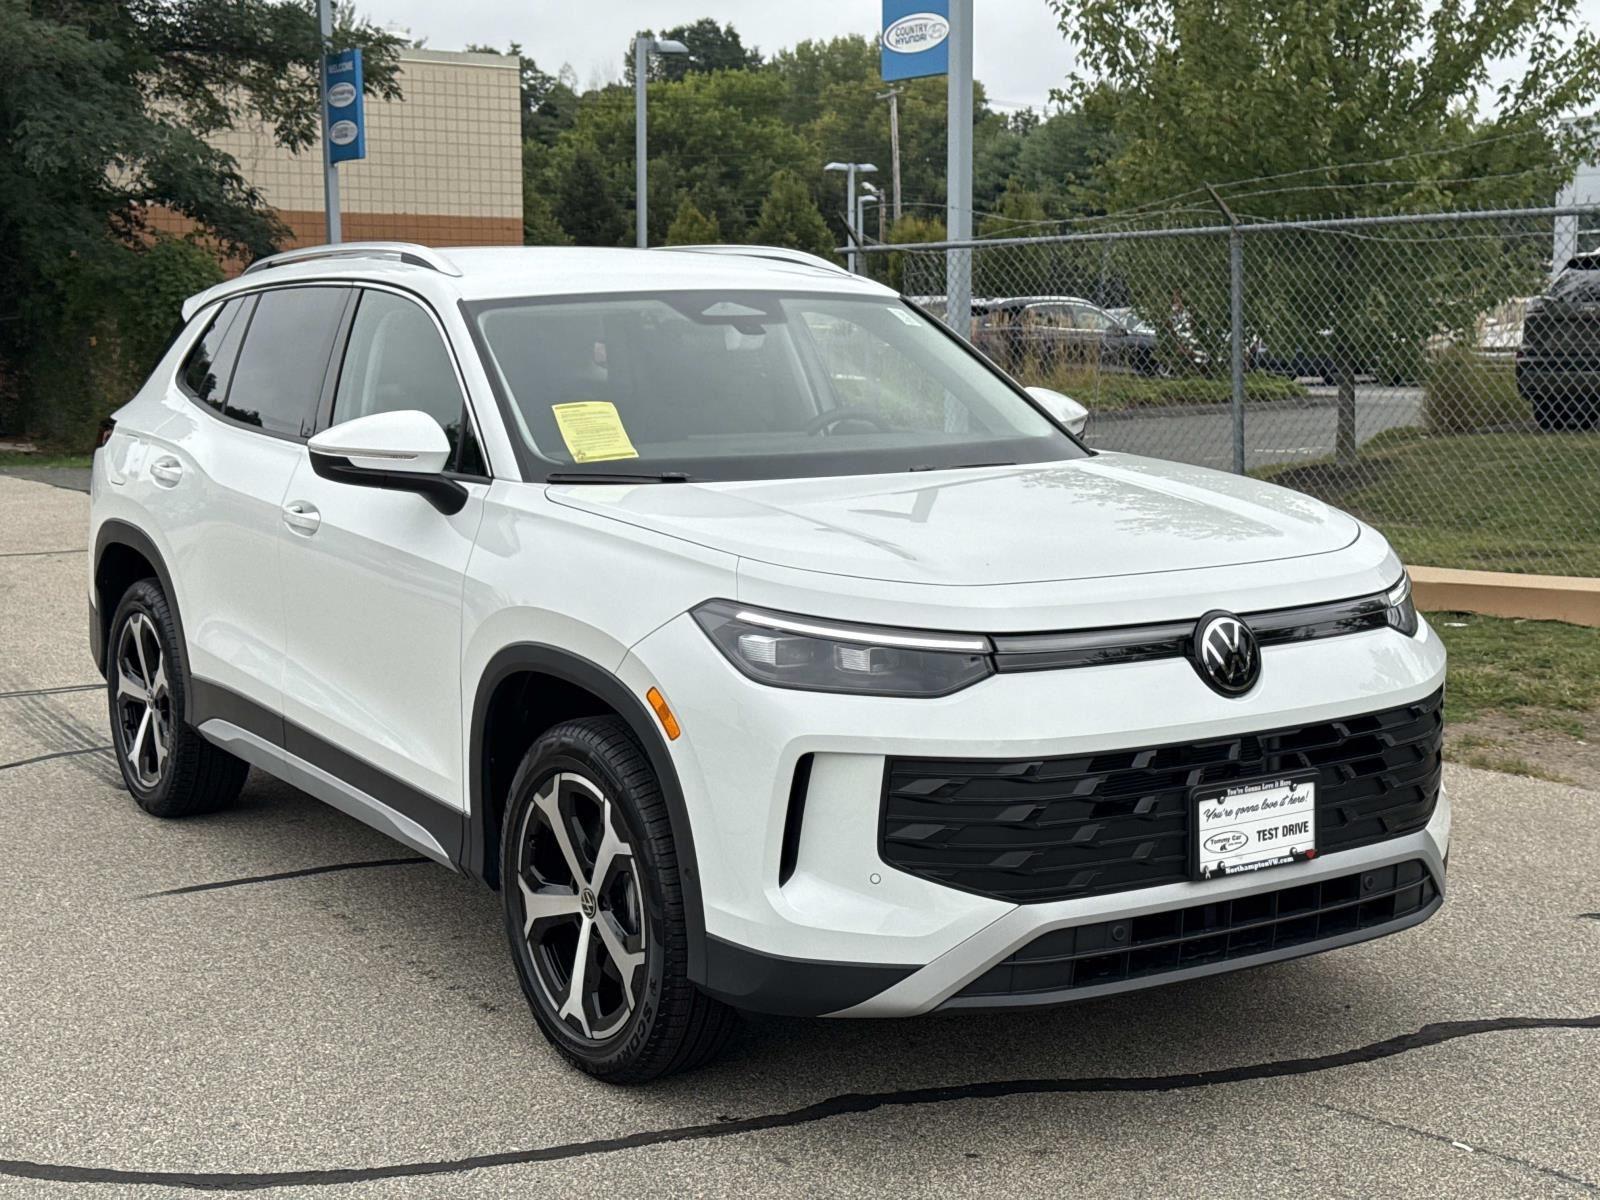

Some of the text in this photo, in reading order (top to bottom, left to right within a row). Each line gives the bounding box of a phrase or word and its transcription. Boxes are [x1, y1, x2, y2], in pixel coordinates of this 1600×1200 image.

[895, 23, 928, 37] COUNTRY
[895, 33, 927, 45] HYUNDAI
[1244, 784, 1261, 793] Gonna
[1262, 782, 1274, 790] Love
[1280, 779, 1291, 787] Here
[1204, 790, 1310, 822] You're gonna love it here!
[1257, 821, 1309, 842] TEST DRIVE
[1210, 836, 1231, 846] Tommy
[1226, 856, 1294, 874] NorthamptonVW.com
